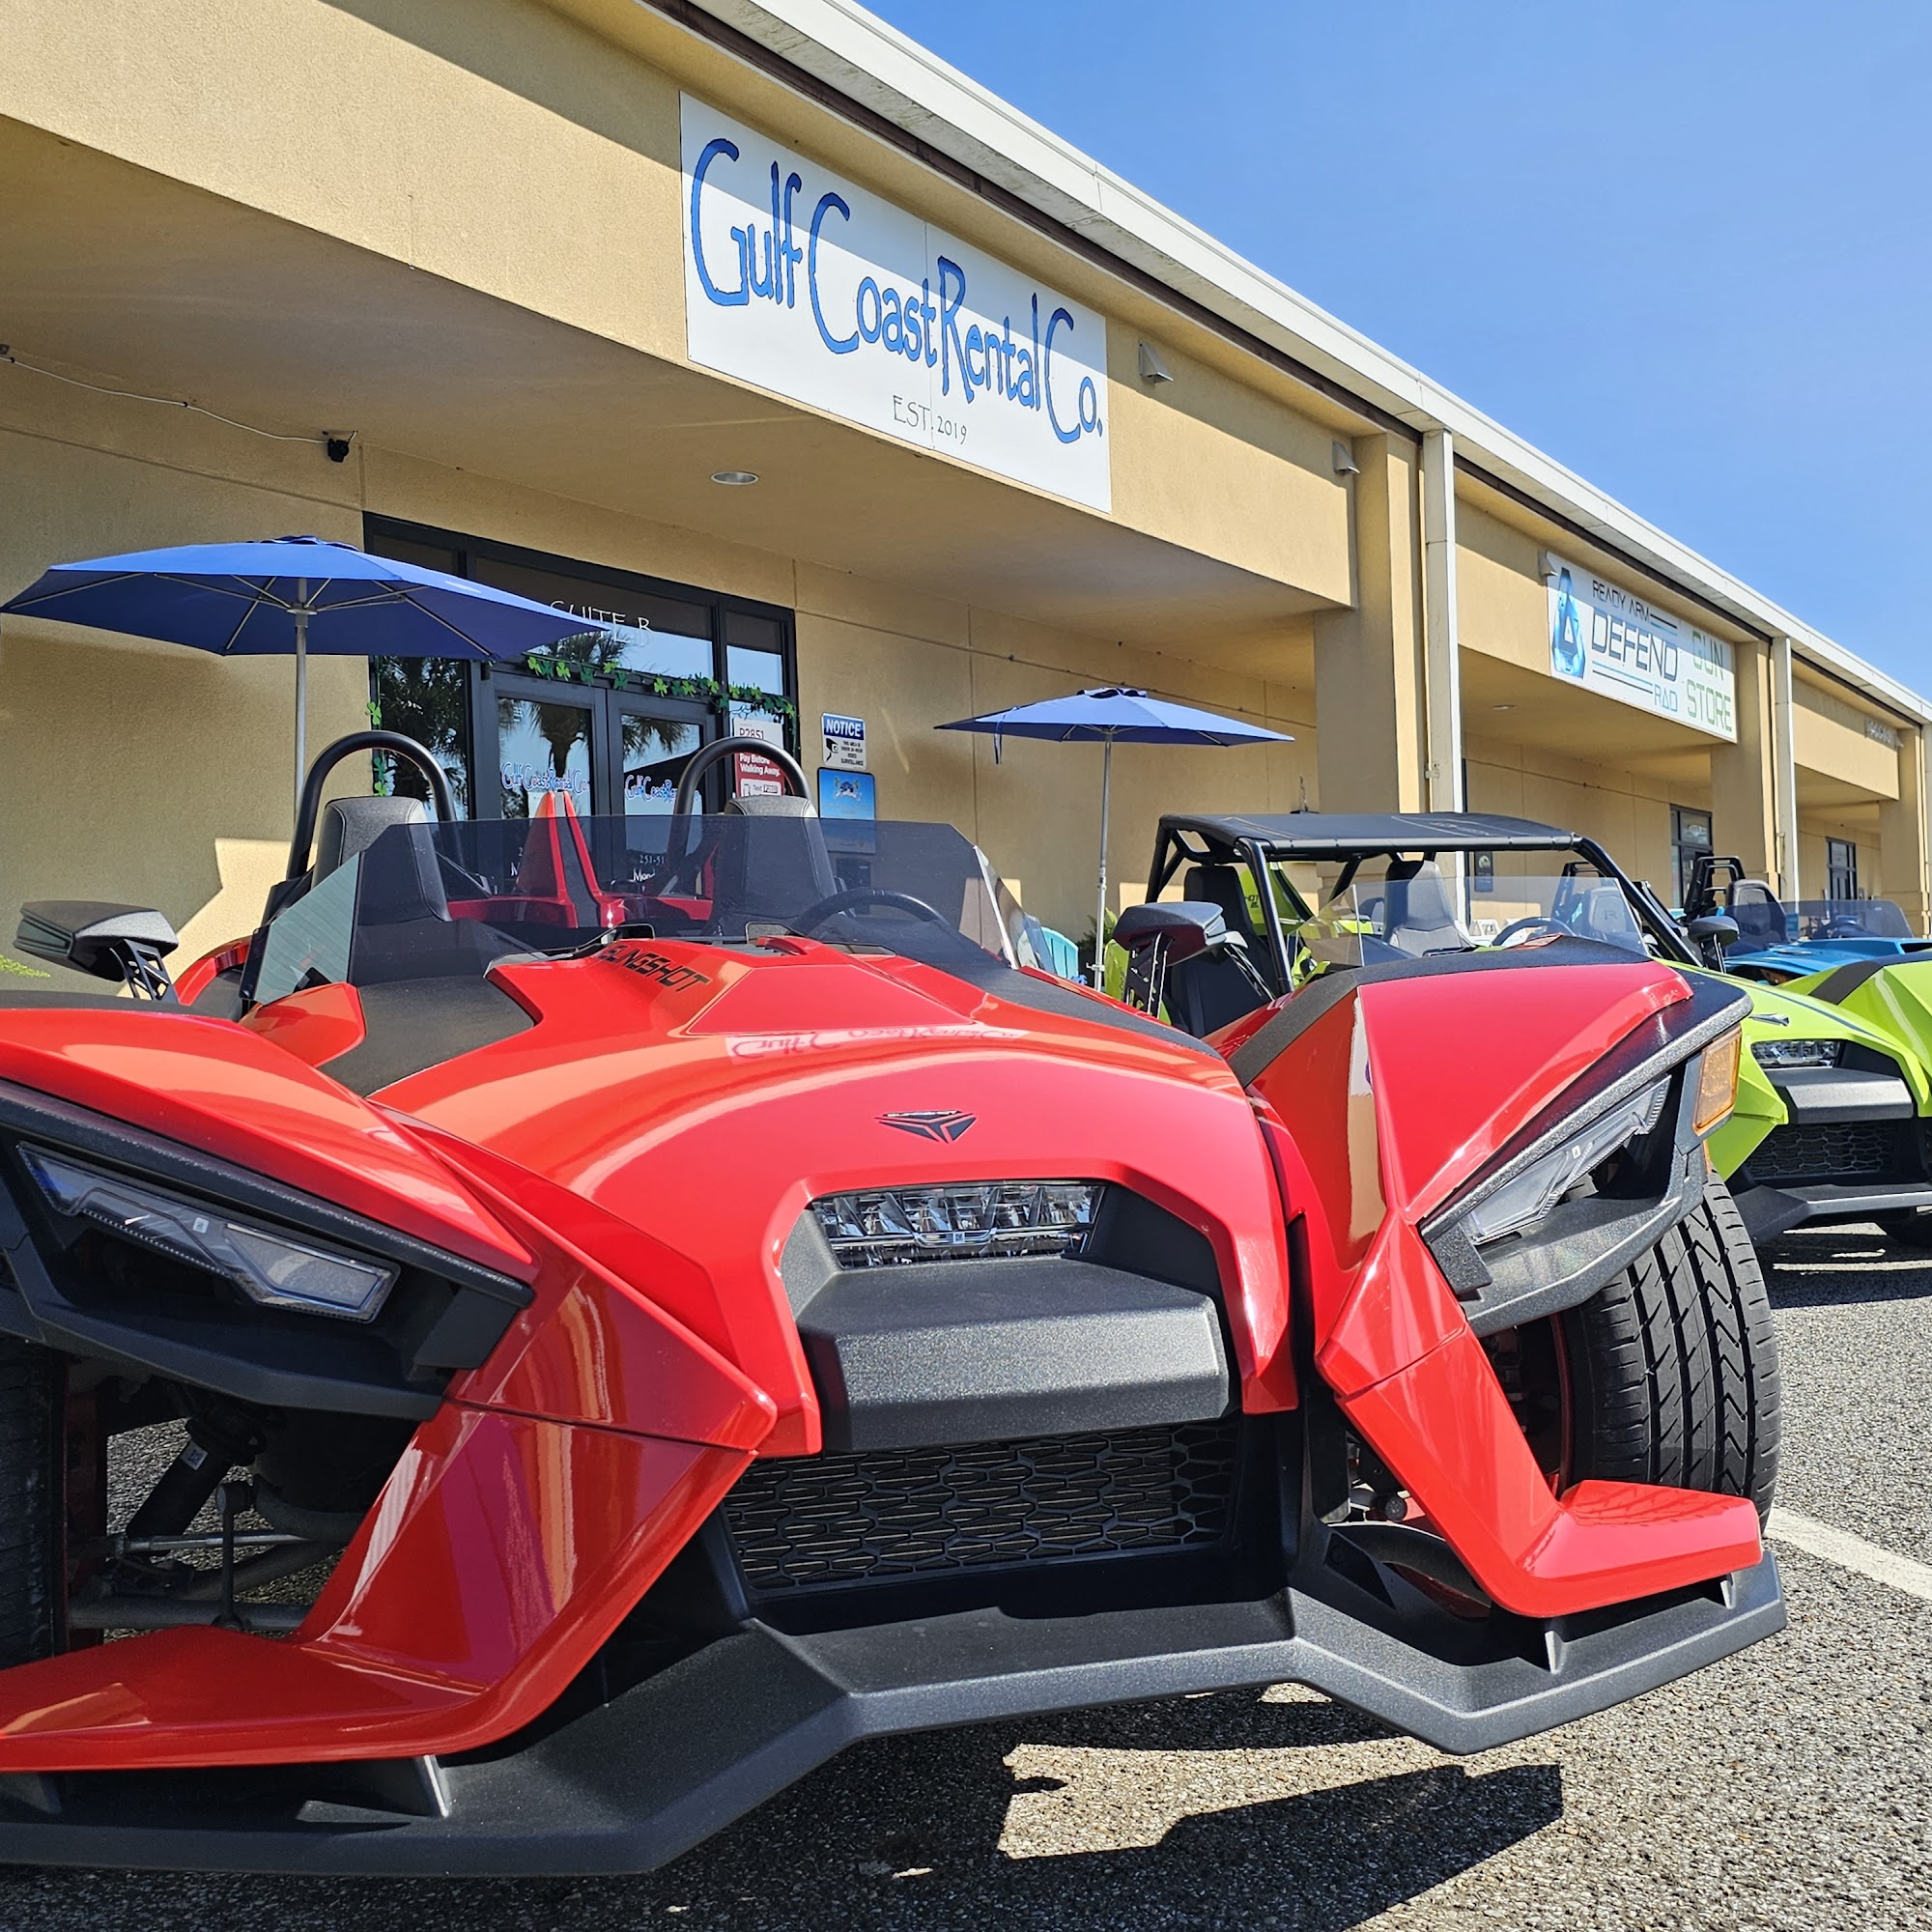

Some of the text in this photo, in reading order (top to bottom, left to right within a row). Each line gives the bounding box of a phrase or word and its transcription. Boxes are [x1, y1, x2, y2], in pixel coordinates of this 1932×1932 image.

[691, 138, 1103, 443] Gulf Coast Rental Co.
[893, 394, 967, 444] EST. 2019
[1592, 580, 1650, 622] READY ARM
[1591, 608, 1678, 682] DEFEND
[1692, 630, 1724, 680] GUN
[826, 718, 862, 737] NOTICE
[1687, 678, 1732, 732] STORE
[739, 753, 752, 766] Pay
[740, 763, 764, 776] Walking
